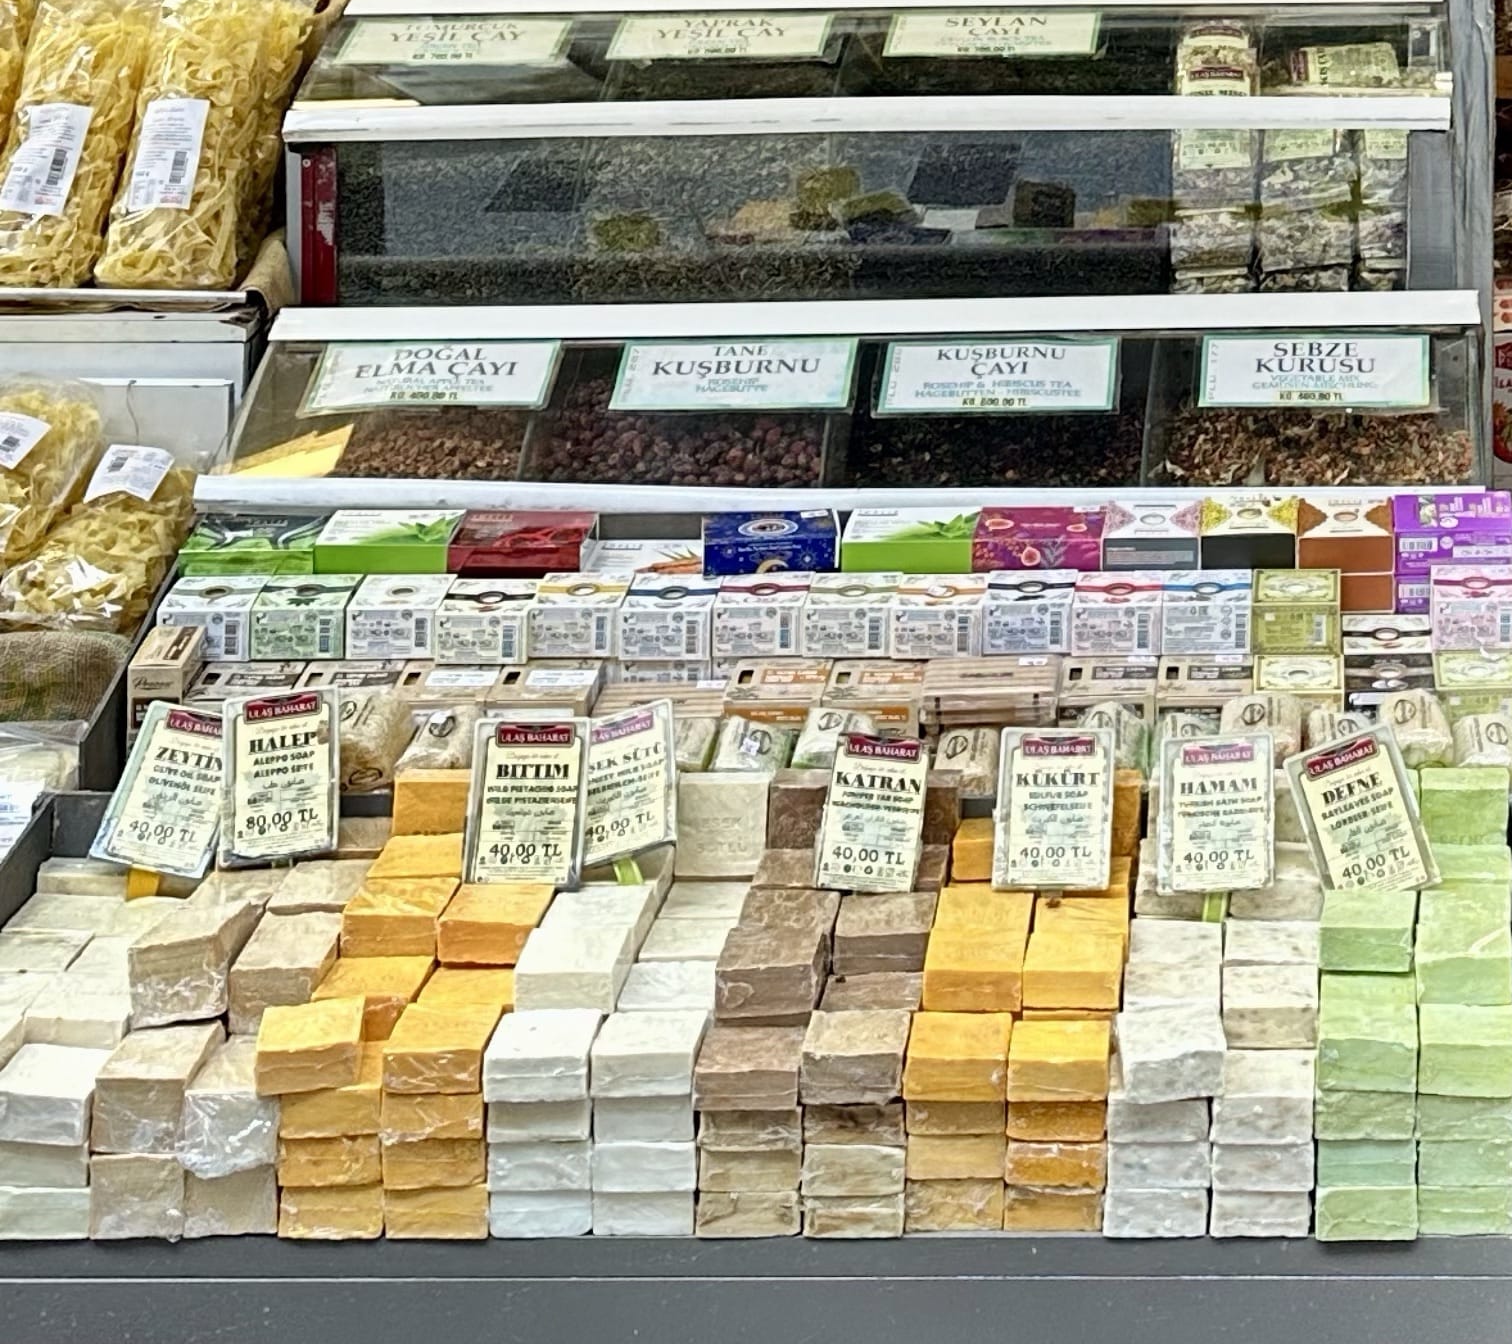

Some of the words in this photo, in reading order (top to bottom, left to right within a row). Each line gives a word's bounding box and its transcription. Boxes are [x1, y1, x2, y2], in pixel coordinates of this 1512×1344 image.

[684, 18, 775, 28] YAPRAK
[946, 16, 1048, 27] SEYLAN
[394, 345, 488, 361] DOĞAL
[714, 345, 769, 357] TANE
[937, 347, 1067, 364] KUŞBURNU
[1273, 342, 1359, 357] SEBZE
[355, 362, 437, 378] ELMA
[447, 361, 519, 381] ÇAYI
[652, 358, 821, 378] KUŞBURNU
[971, 361, 1028, 379] ÇAYI
[1255, 358, 1376, 374] KURUSU
[276, 700, 317, 716] BAHARAT
[249, 731, 317, 755] HALEP
[527, 732, 569, 743] BAHARAT
[254, 753, 288, 765] ALEPPO
[290, 750, 315, 760] SOAP
[875, 745, 917, 758] BAHARAT
[254, 766, 289, 778] ALEPPO
[1016, 769, 1101, 787] KÜKÜRT
[836, 771, 921, 794] KATRAN
[1180, 777, 1258, 796] HAMAM
[1322, 773, 1383, 805] DEFNE
[1370, 787, 1395, 802] SOAP
[297, 807, 318, 821] TL
[180, 829, 198, 843] TL
[542, 843, 562, 857] TL
[832, 846, 879, 864] 40,00
[884, 850, 906, 865] TL
[1071, 846, 1092, 858] TL
[1235, 850, 1254, 861] TL
[1390, 845, 1410, 860] TL
